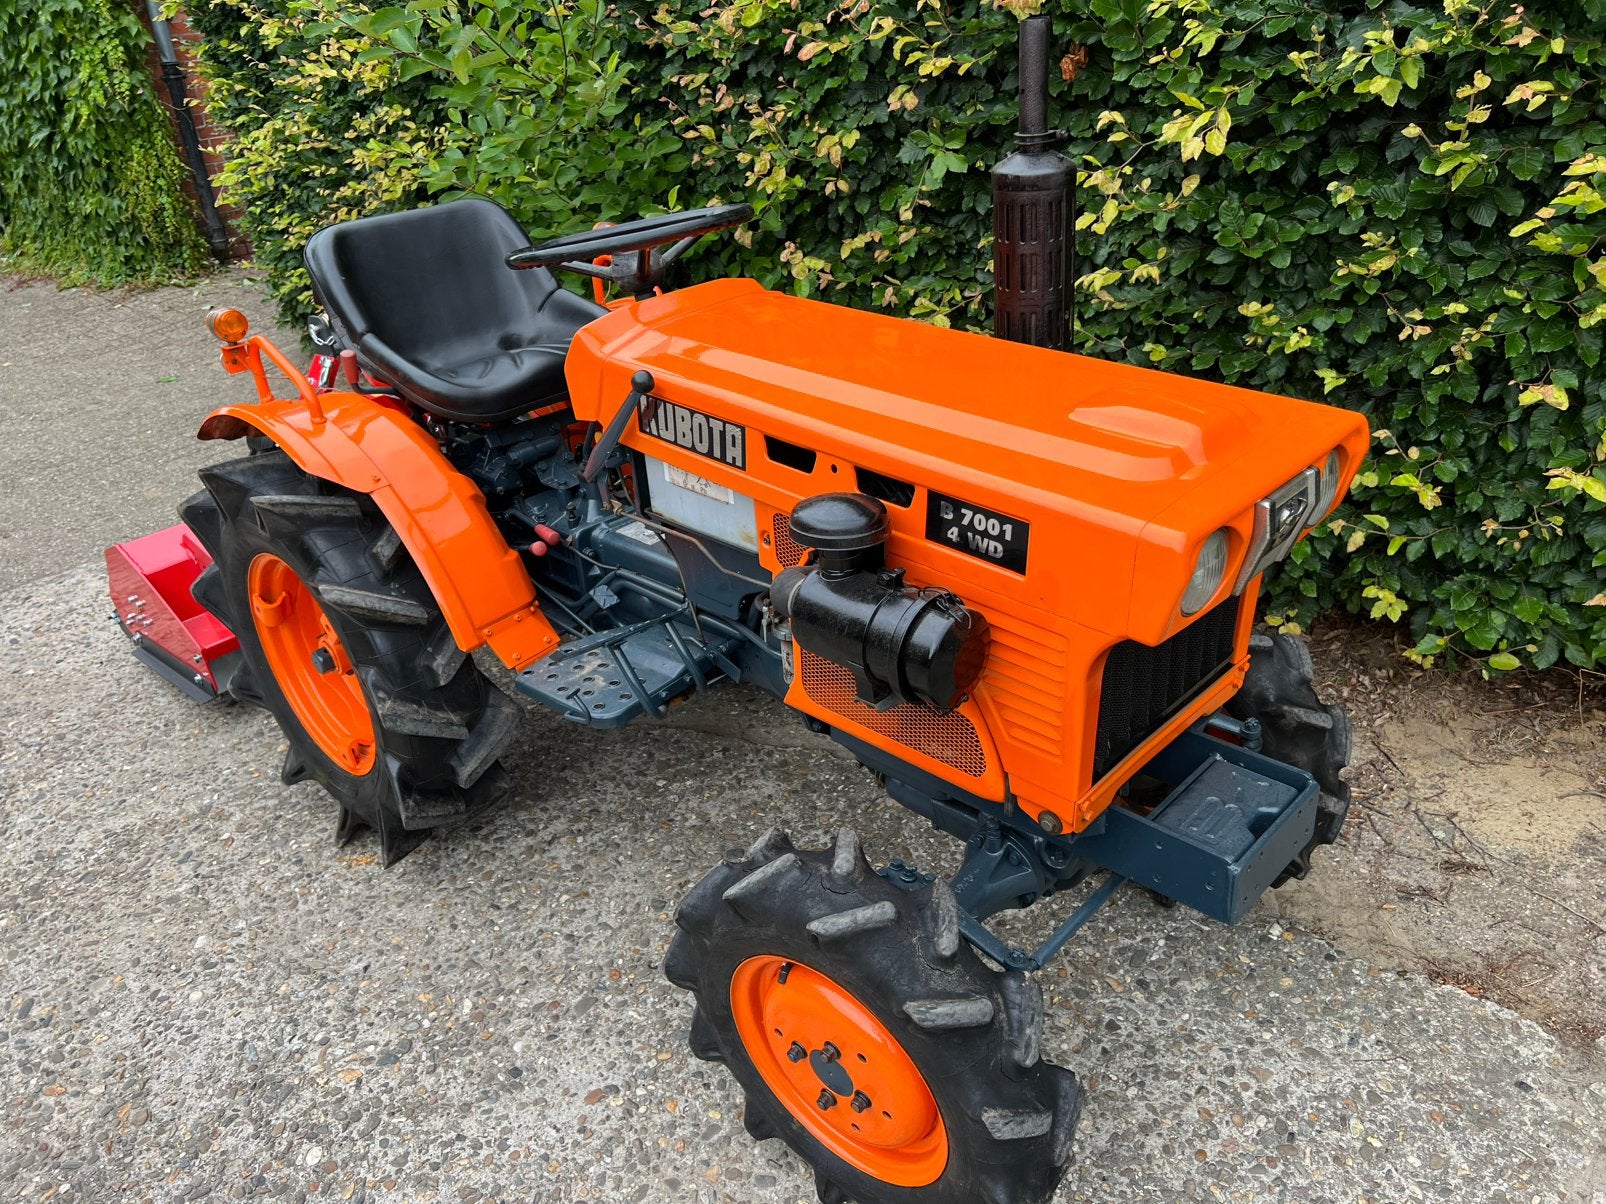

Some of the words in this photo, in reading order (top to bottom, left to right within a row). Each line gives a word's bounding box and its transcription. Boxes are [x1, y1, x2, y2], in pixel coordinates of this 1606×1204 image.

[639, 394, 743, 468] KUBOTA
[940, 500, 954, 520] B
[961, 507, 1013, 541] 7001
[946, 526, 960, 544] 4
[967, 531, 1004, 559] WD
